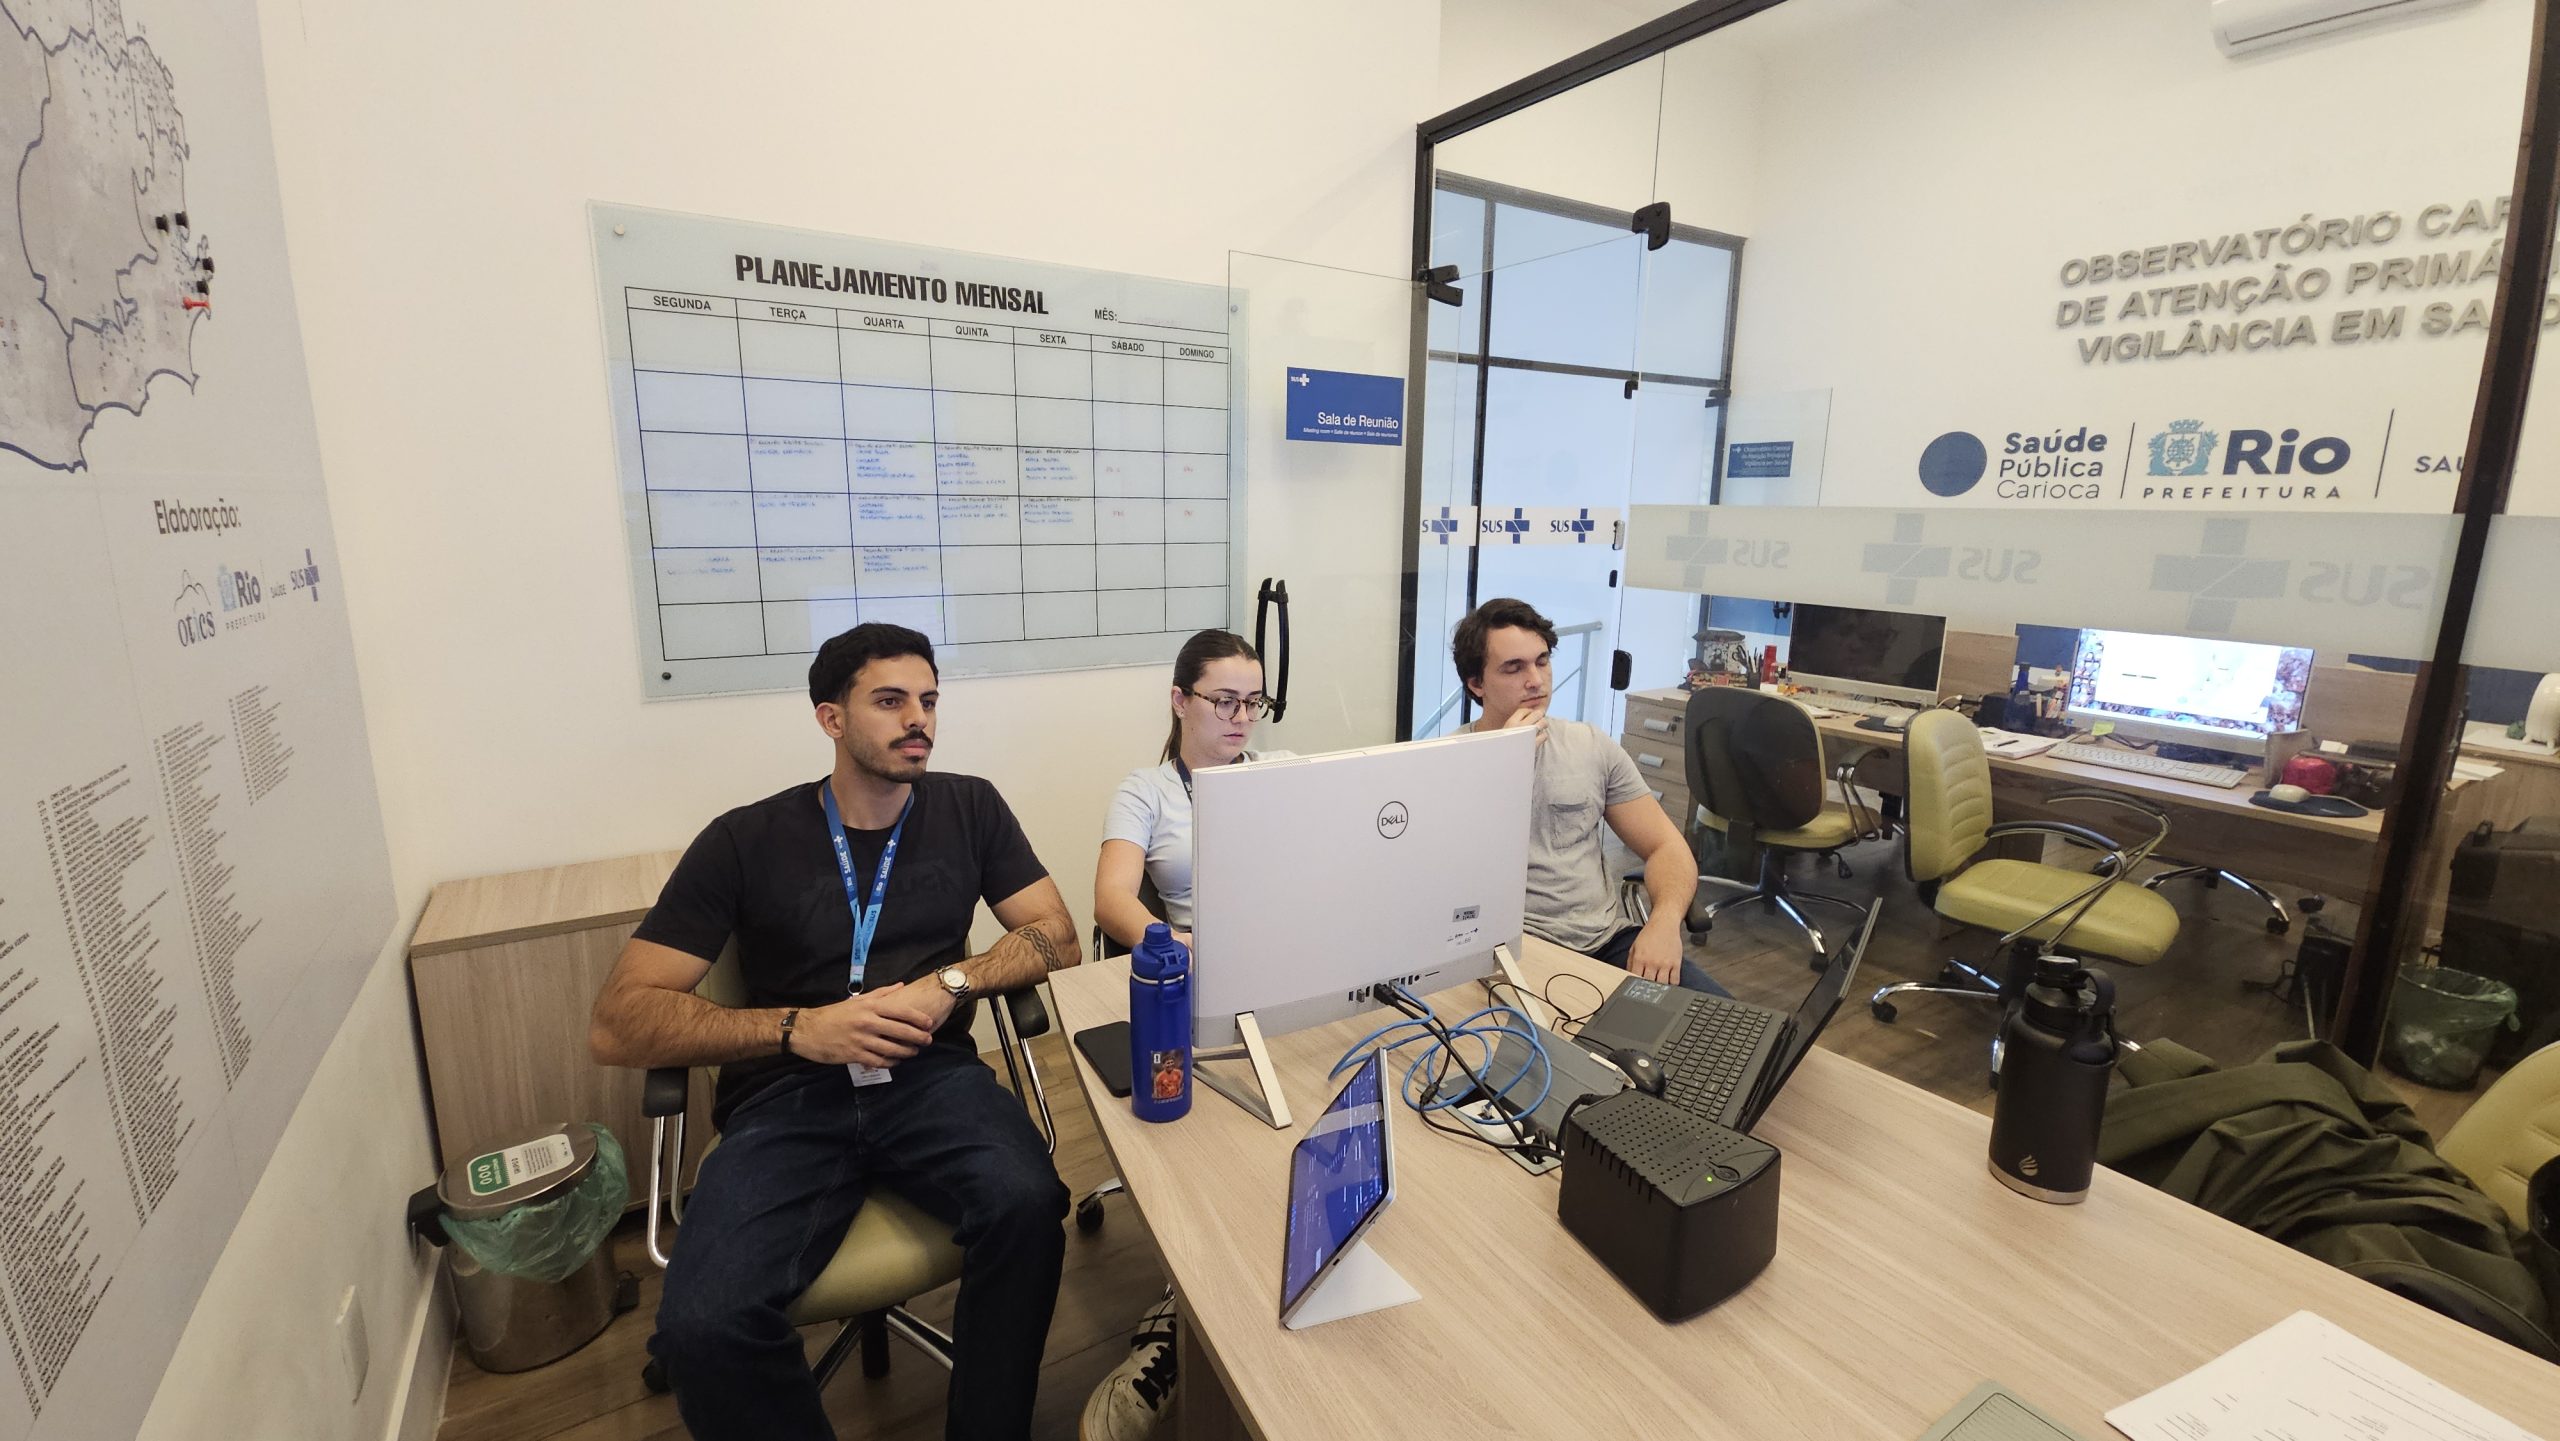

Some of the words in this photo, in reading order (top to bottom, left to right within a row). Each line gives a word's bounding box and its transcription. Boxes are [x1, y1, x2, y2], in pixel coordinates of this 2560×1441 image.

[2060, 210, 2402, 287] OBSERVATÓRIO
[735, 254, 947, 303] PLANEJAMENTO
[955, 280, 1048, 315] MENSAL
[2056, 295, 2108, 328] DE
[2118, 263, 2331, 320] ATENÇÃO
[2345, 238, 2560, 294] PRIMÁ
[653, 295, 712, 311] SEGUNDA
[769, 306, 806, 321] TERÇA
[1094, 307, 1118, 322] MÊS:
[863, 316, 904, 329] QUARTA
[955, 325, 989, 338] QUINTA
[1040, 333, 1067, 345] SEXTA
[2078, 319, 2317, 364] VIGILÂNCIA
[2331, 306, 2406, 343] EM
[1111, 340, 1145, 352] SÁBADO
[1179, 347, 1214, 359] DOMINGO
[1318, 412, 1341, 425] Sala
[1343, 414, 1356, 426] de
[1359, 415, 1399, 429] Reunião
[2004, 427, 2107, 454] Saúde
[2223, 428, 2351, 475] Rio
[1999, 456, 2104, 478] Pública
[1997, 479, 2100, 499] Carioca
[2143, 486, 2340, 499] PREFEITURA
[154, 498, 241, 536] Elaboração:
[1481, 519, 1503, 533] SUS
[1550, 520, 1570, 533] SUS
[234, 570, 261, 607] Rio
[1381, 813, 1405, 826] DELL
